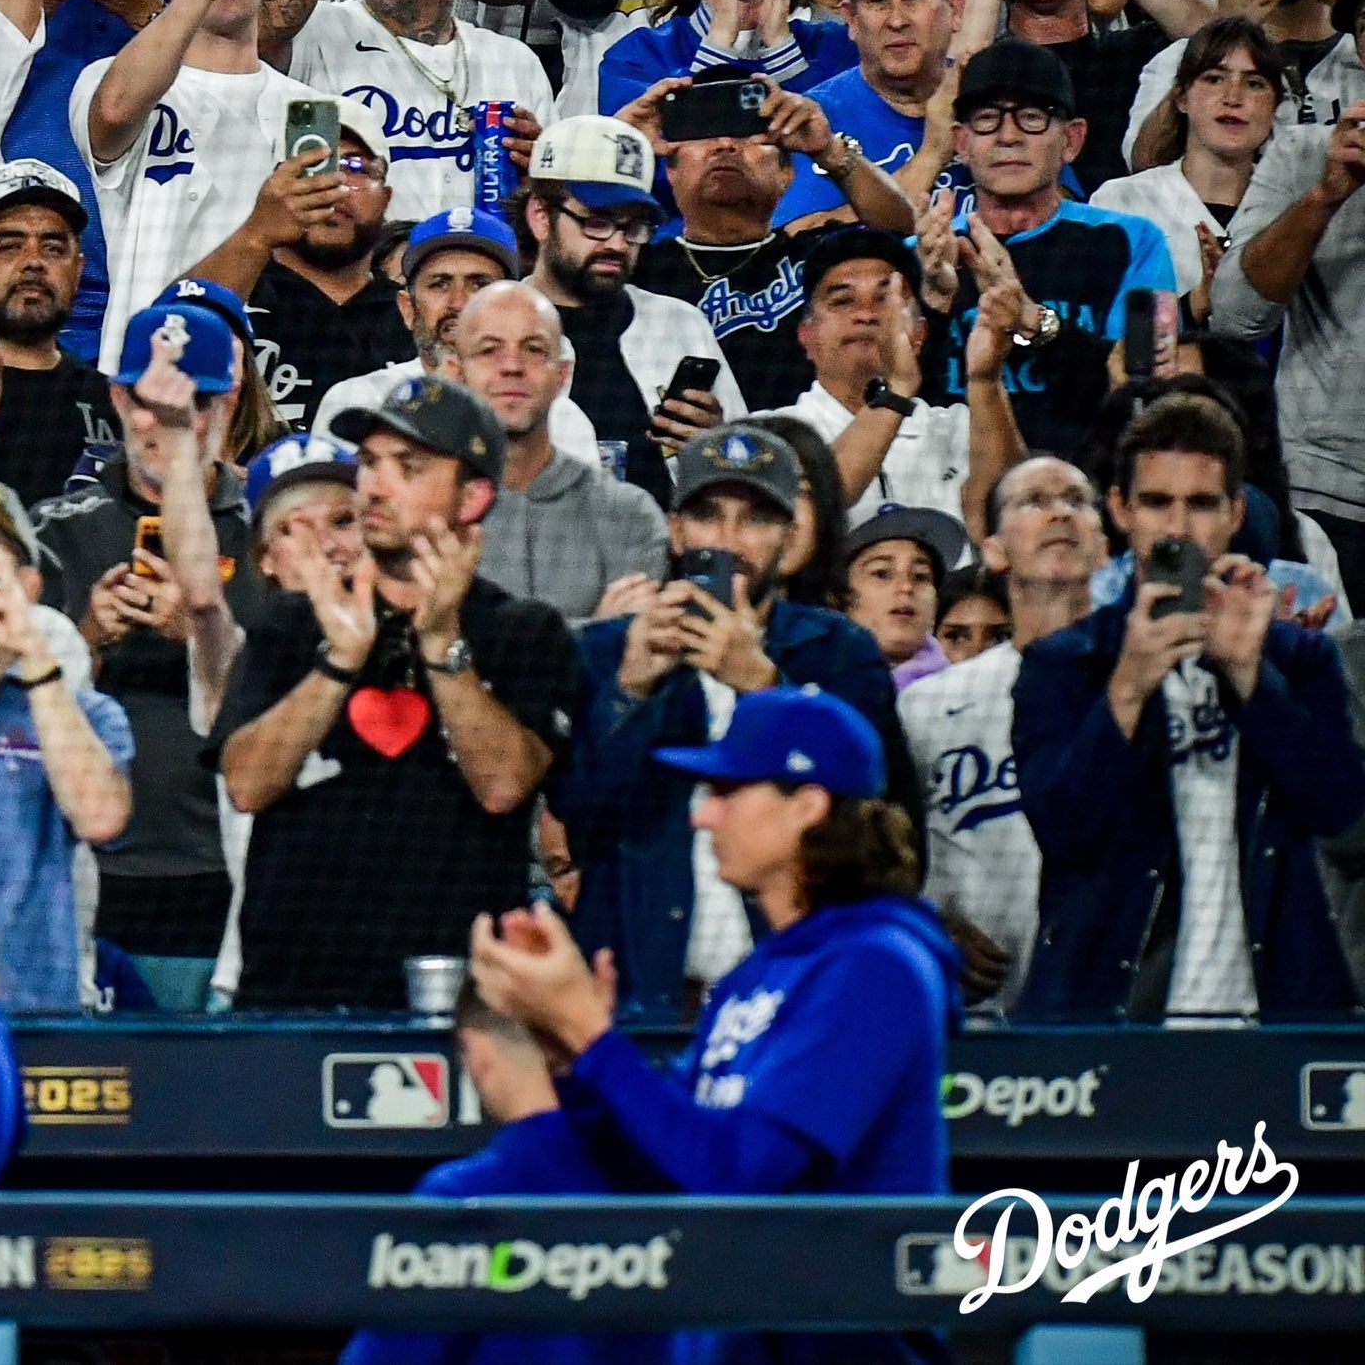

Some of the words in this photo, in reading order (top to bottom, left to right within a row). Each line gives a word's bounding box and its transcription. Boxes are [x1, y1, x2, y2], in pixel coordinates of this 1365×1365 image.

[483, 133, 500, 203] ULTRA
[178, 281, 205, 296] LA
[25, 1077, 132, 1113] 025
[941, 1068, 1101, 1127] Depot
[368, 1235, 671, 1300] loanDepot
